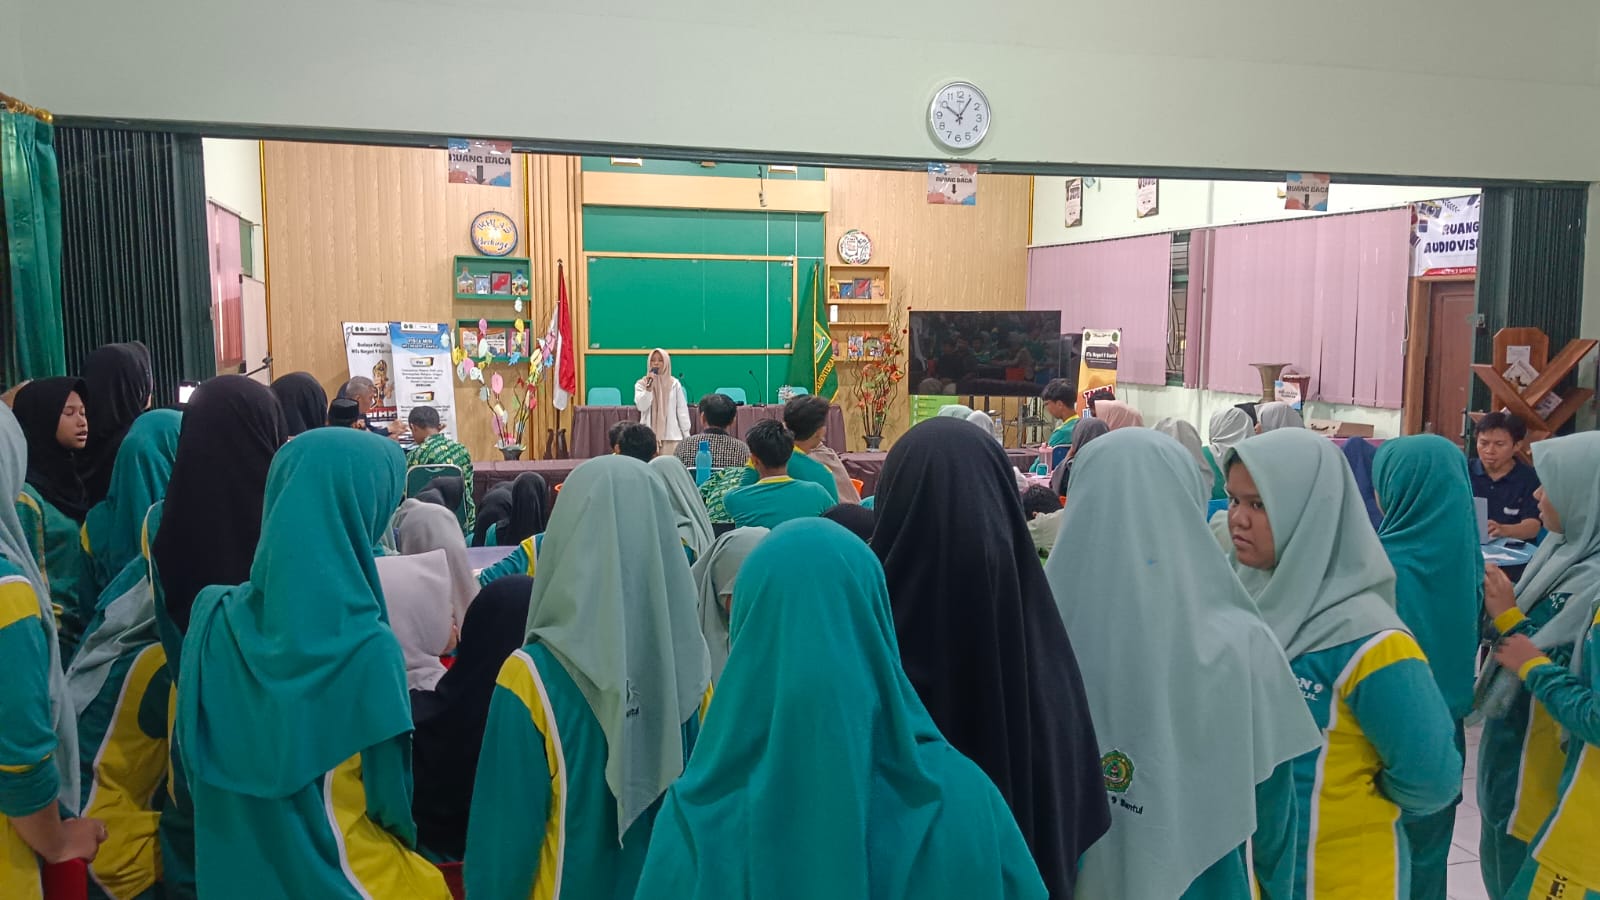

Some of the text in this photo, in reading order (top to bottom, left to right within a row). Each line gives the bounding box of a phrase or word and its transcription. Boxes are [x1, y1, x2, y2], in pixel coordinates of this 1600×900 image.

[947, 93, 954, 101] 11
[956, 91, 965, 99] 12
[974, 103, 980, 111] 2
[936, 111, 943, 119] 9
[975, 114, 982, 122] 3
[939, 122, 945, 130] 8
[946, 131, 952, 139] 7
[965, 132, 972, 140] 5
[485, 156, 511, 165] BACA
[1442, 221, 1479, 235] RUANG
[1313, 683, 1323, 694] 9
[1111, 796, 1143, 815] 9 Bantul
